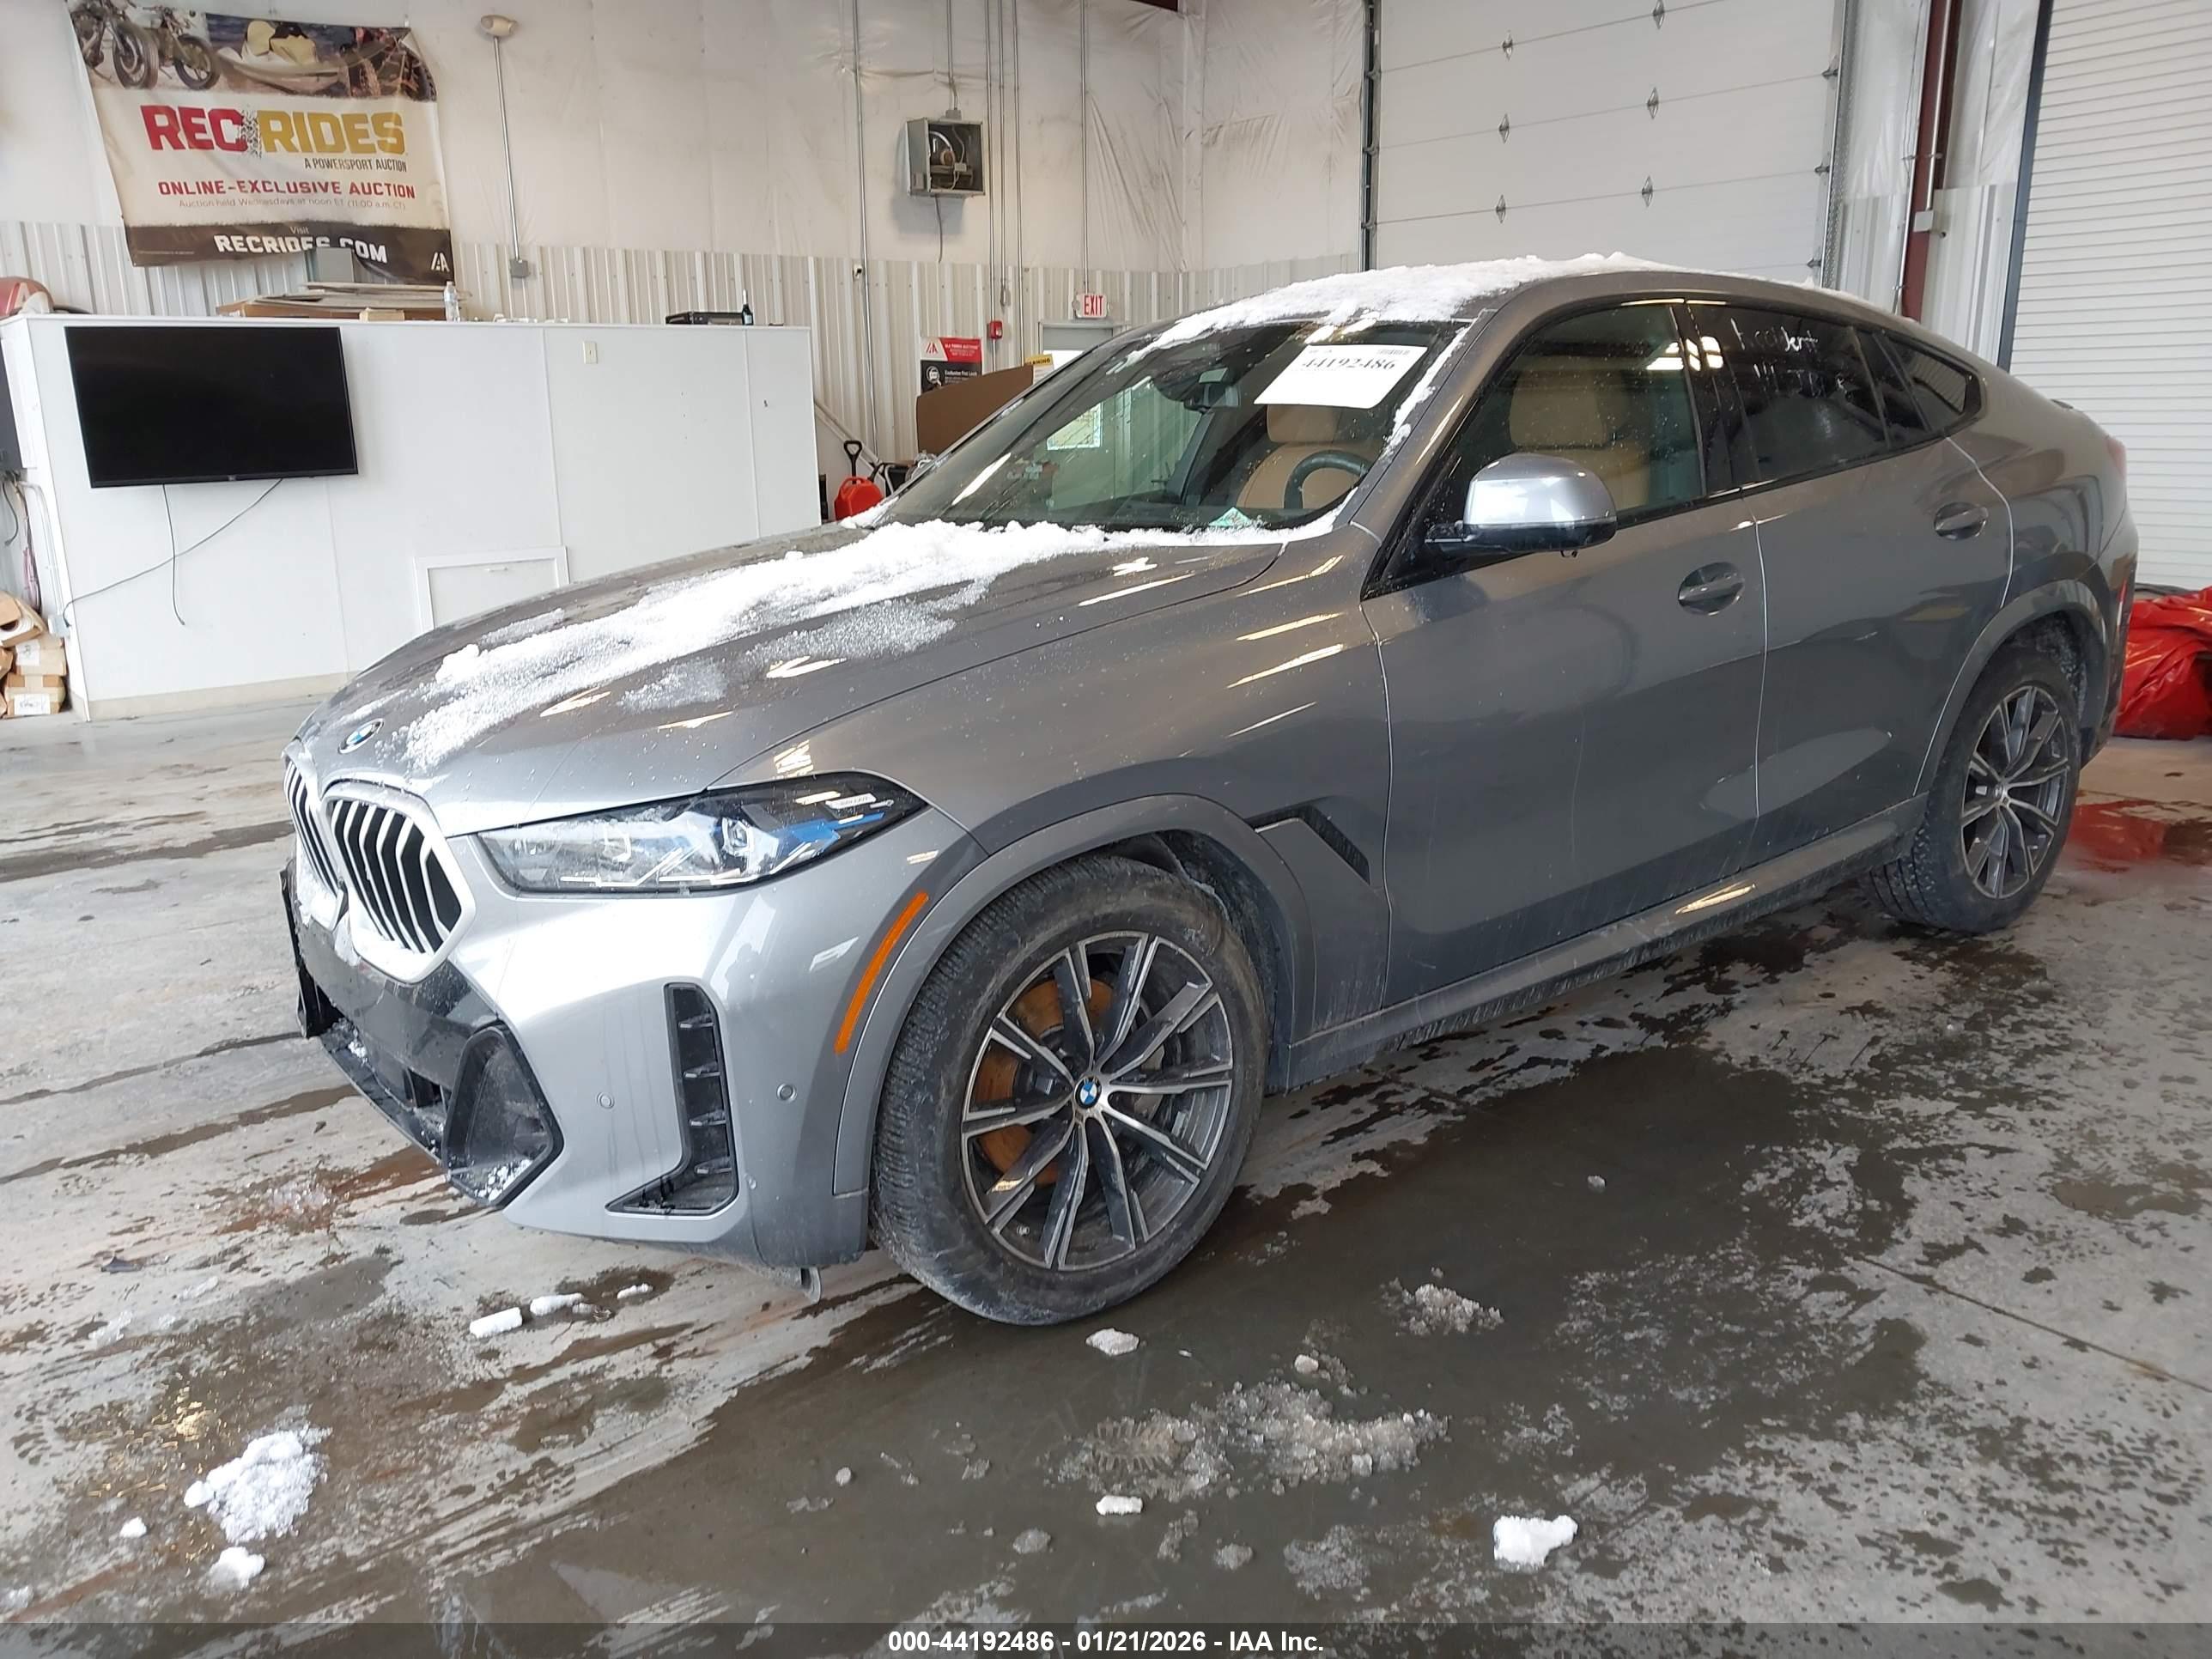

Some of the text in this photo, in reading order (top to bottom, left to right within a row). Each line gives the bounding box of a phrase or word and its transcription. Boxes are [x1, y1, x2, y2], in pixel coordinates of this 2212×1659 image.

[140, 106, 405, 155] REC RIDES
[304, 158, 407, 172] A POWERSPORT AUCTION
[158, 180, 416, 198] ONLINE-EXCLUSIVE AUCTION
[179, 198, 215, 207] Auction
[289, 226, 309, 234] Visit
[214, 234, 388, 263] RECRIDESCOM
[1084, 295, 1103, 316] EXIT
[1302, 356, 1396, 370] 44192486
